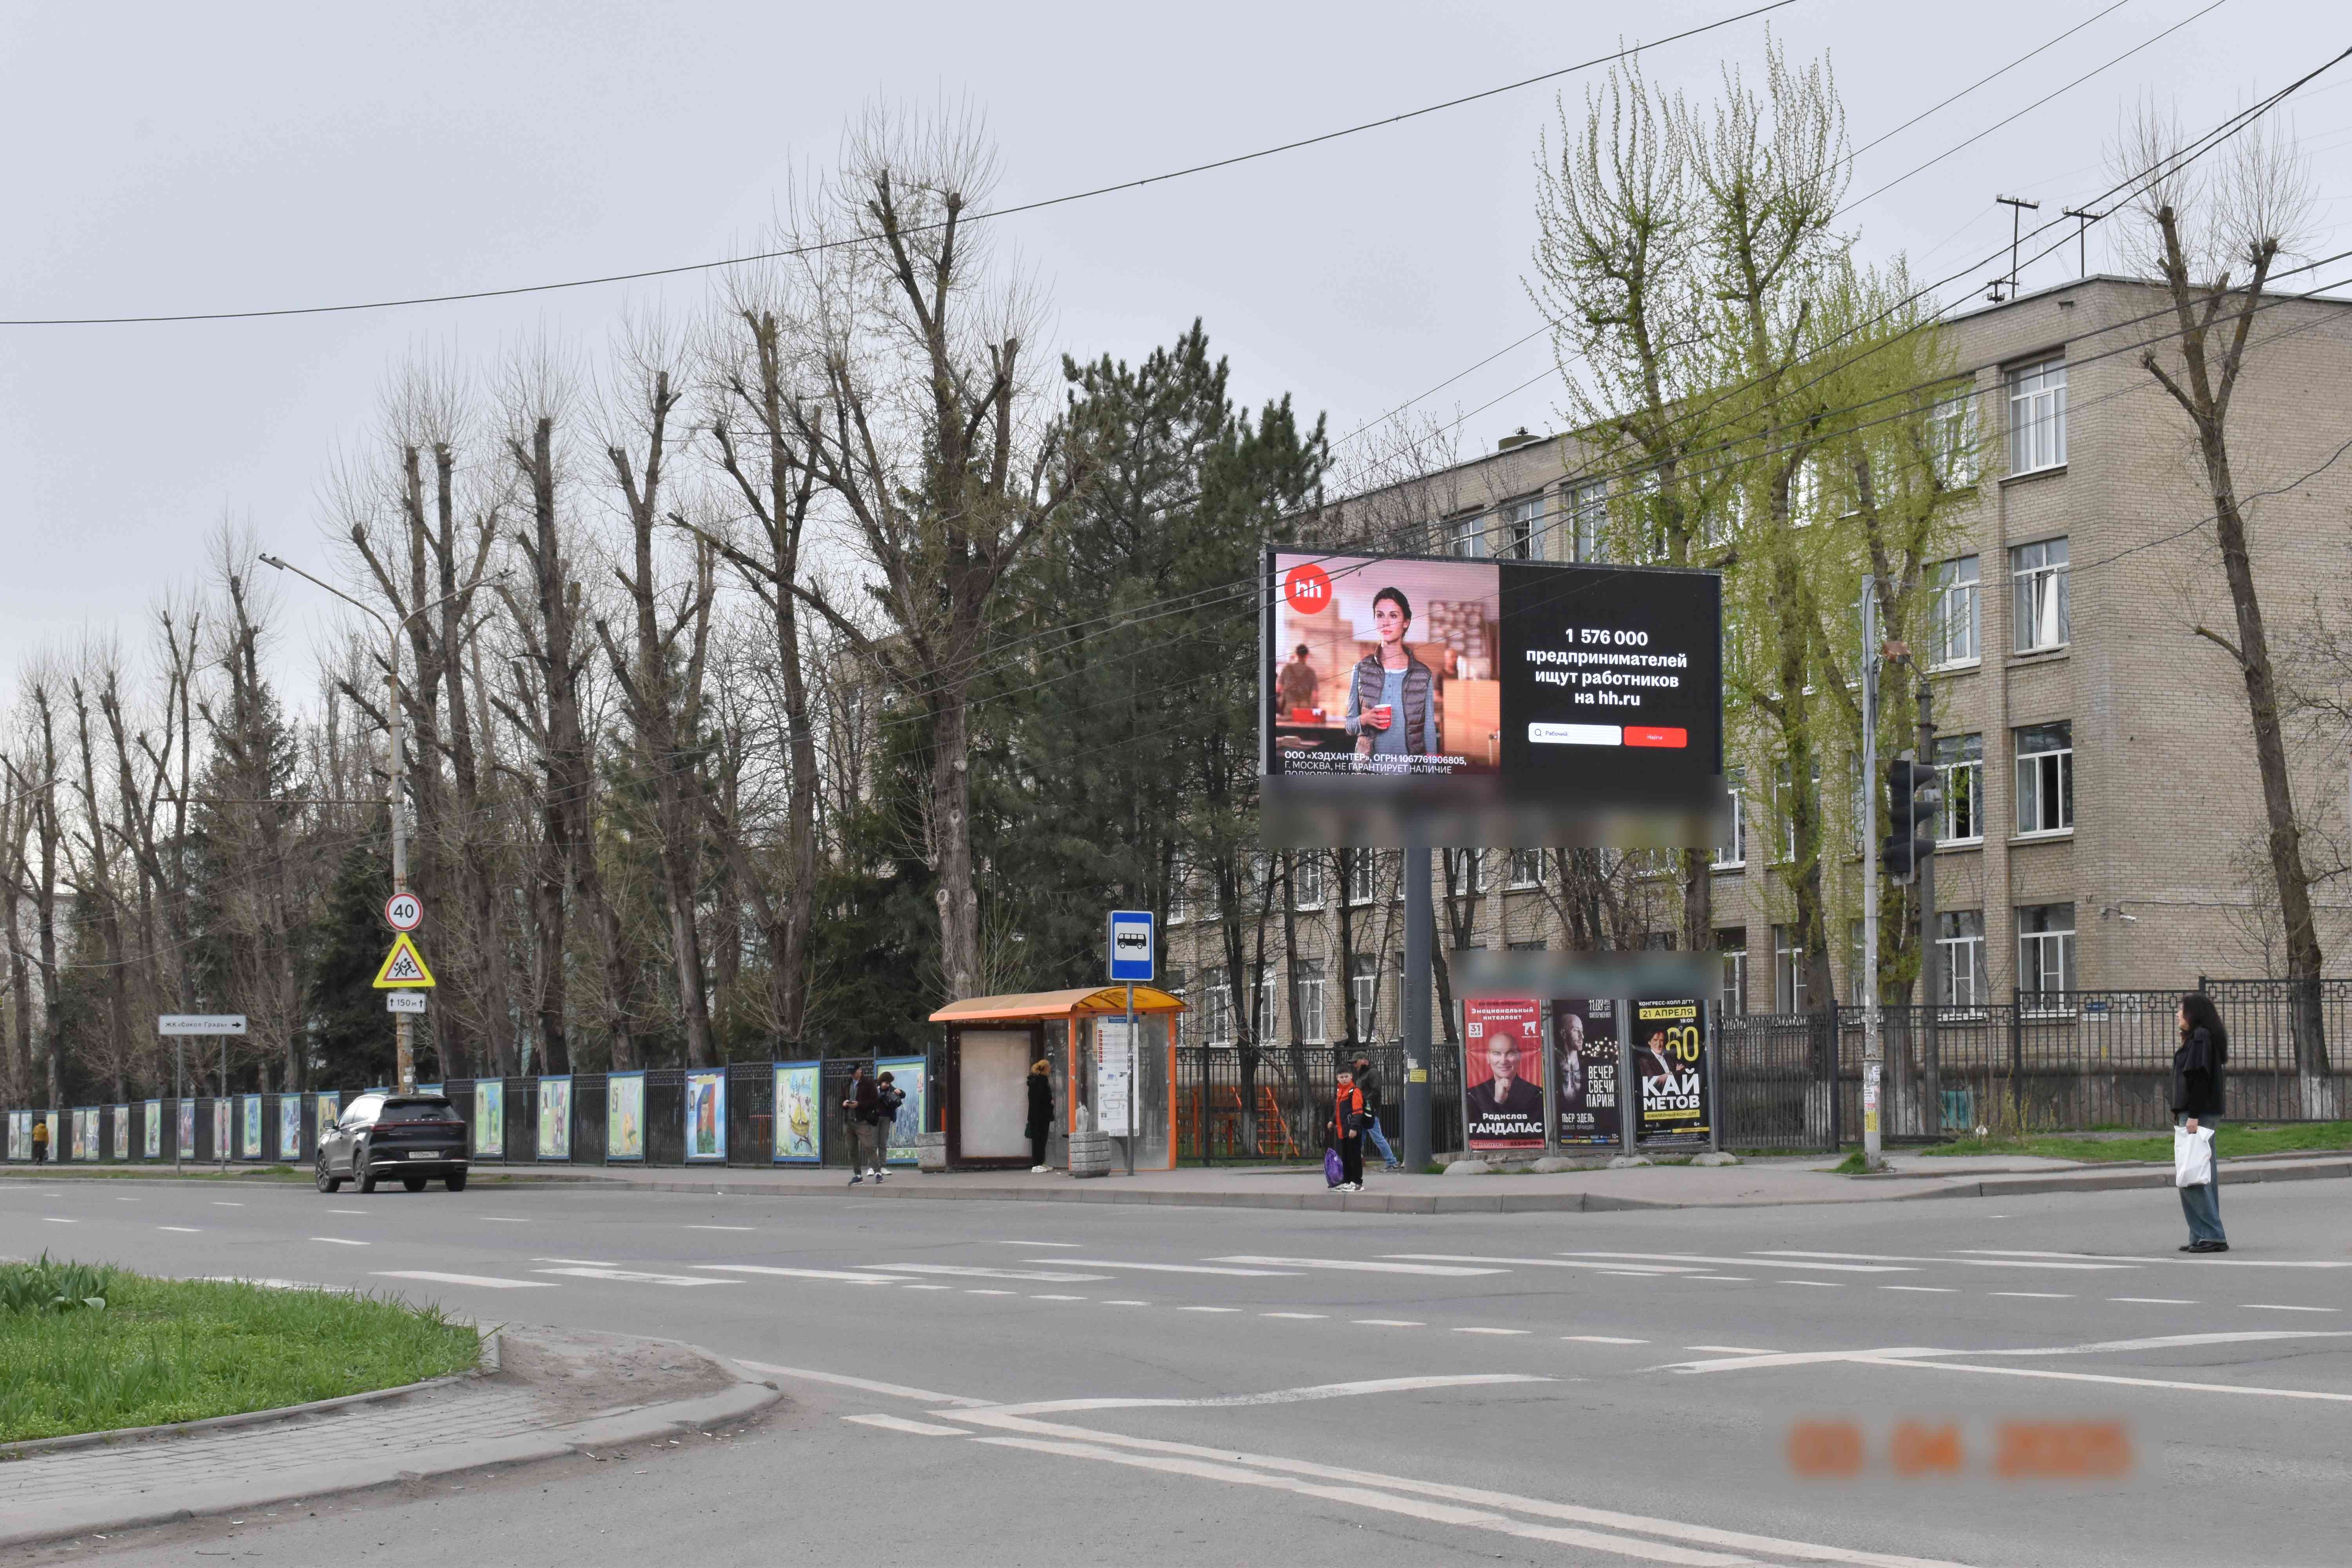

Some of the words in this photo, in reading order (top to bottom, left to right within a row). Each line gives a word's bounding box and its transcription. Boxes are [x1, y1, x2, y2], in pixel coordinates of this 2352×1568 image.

[1296, 579, 1321, 598] hh
[1565, 628, 1573, 642] 1
[1581, 629, 1610, 644] 576
[1614, 630, 1648, 646] 000
[1526, 650, 1687, 668] предпринимателей
[1535, 671, 1578, 686] ищут
[1582, 670, 1679, 687] работников
[1575, 693, 1594, 704] на
[1599, 690, 1640, 706] hh.ru
[1285, 751, 1305, 759] ООО
[1307, 752, 1372, 762] «ХЭДХАНТЕР»,
[1373, 754, 1397, 762] ОГРН
[1398, 755, 1467, 766] 1067761906805,
[1293, 761, 1333, 771] МОСКВА,
[1348, 762, 1408, 772] ГАРАНТИРУЕТ
[1410, 765, 1452, 774] НАЛИЧИЕ
[393, 904, 414, 918] 40
[1655, 1008, 1693, 1017] АПРЕЛЯ
[1588, 1065, 1613, 1079] ВЕЧЕР
[1588, 1080, 1614, 1093] СВЕЧИ
[1642, 1068, 1700, 1096] КАЙ
[1586, 1094, 1615, 1107] ПАРИЖ
[1643, 1095, 1700, 1111] МЕТОВ
[1562, 1113, 1575, 1123] ПЬЕР
[1577, 1113, 1594, 1123] ЭДЕЛЬ
[1469, 1122, 1543, 1135] ГАНДАПАС
